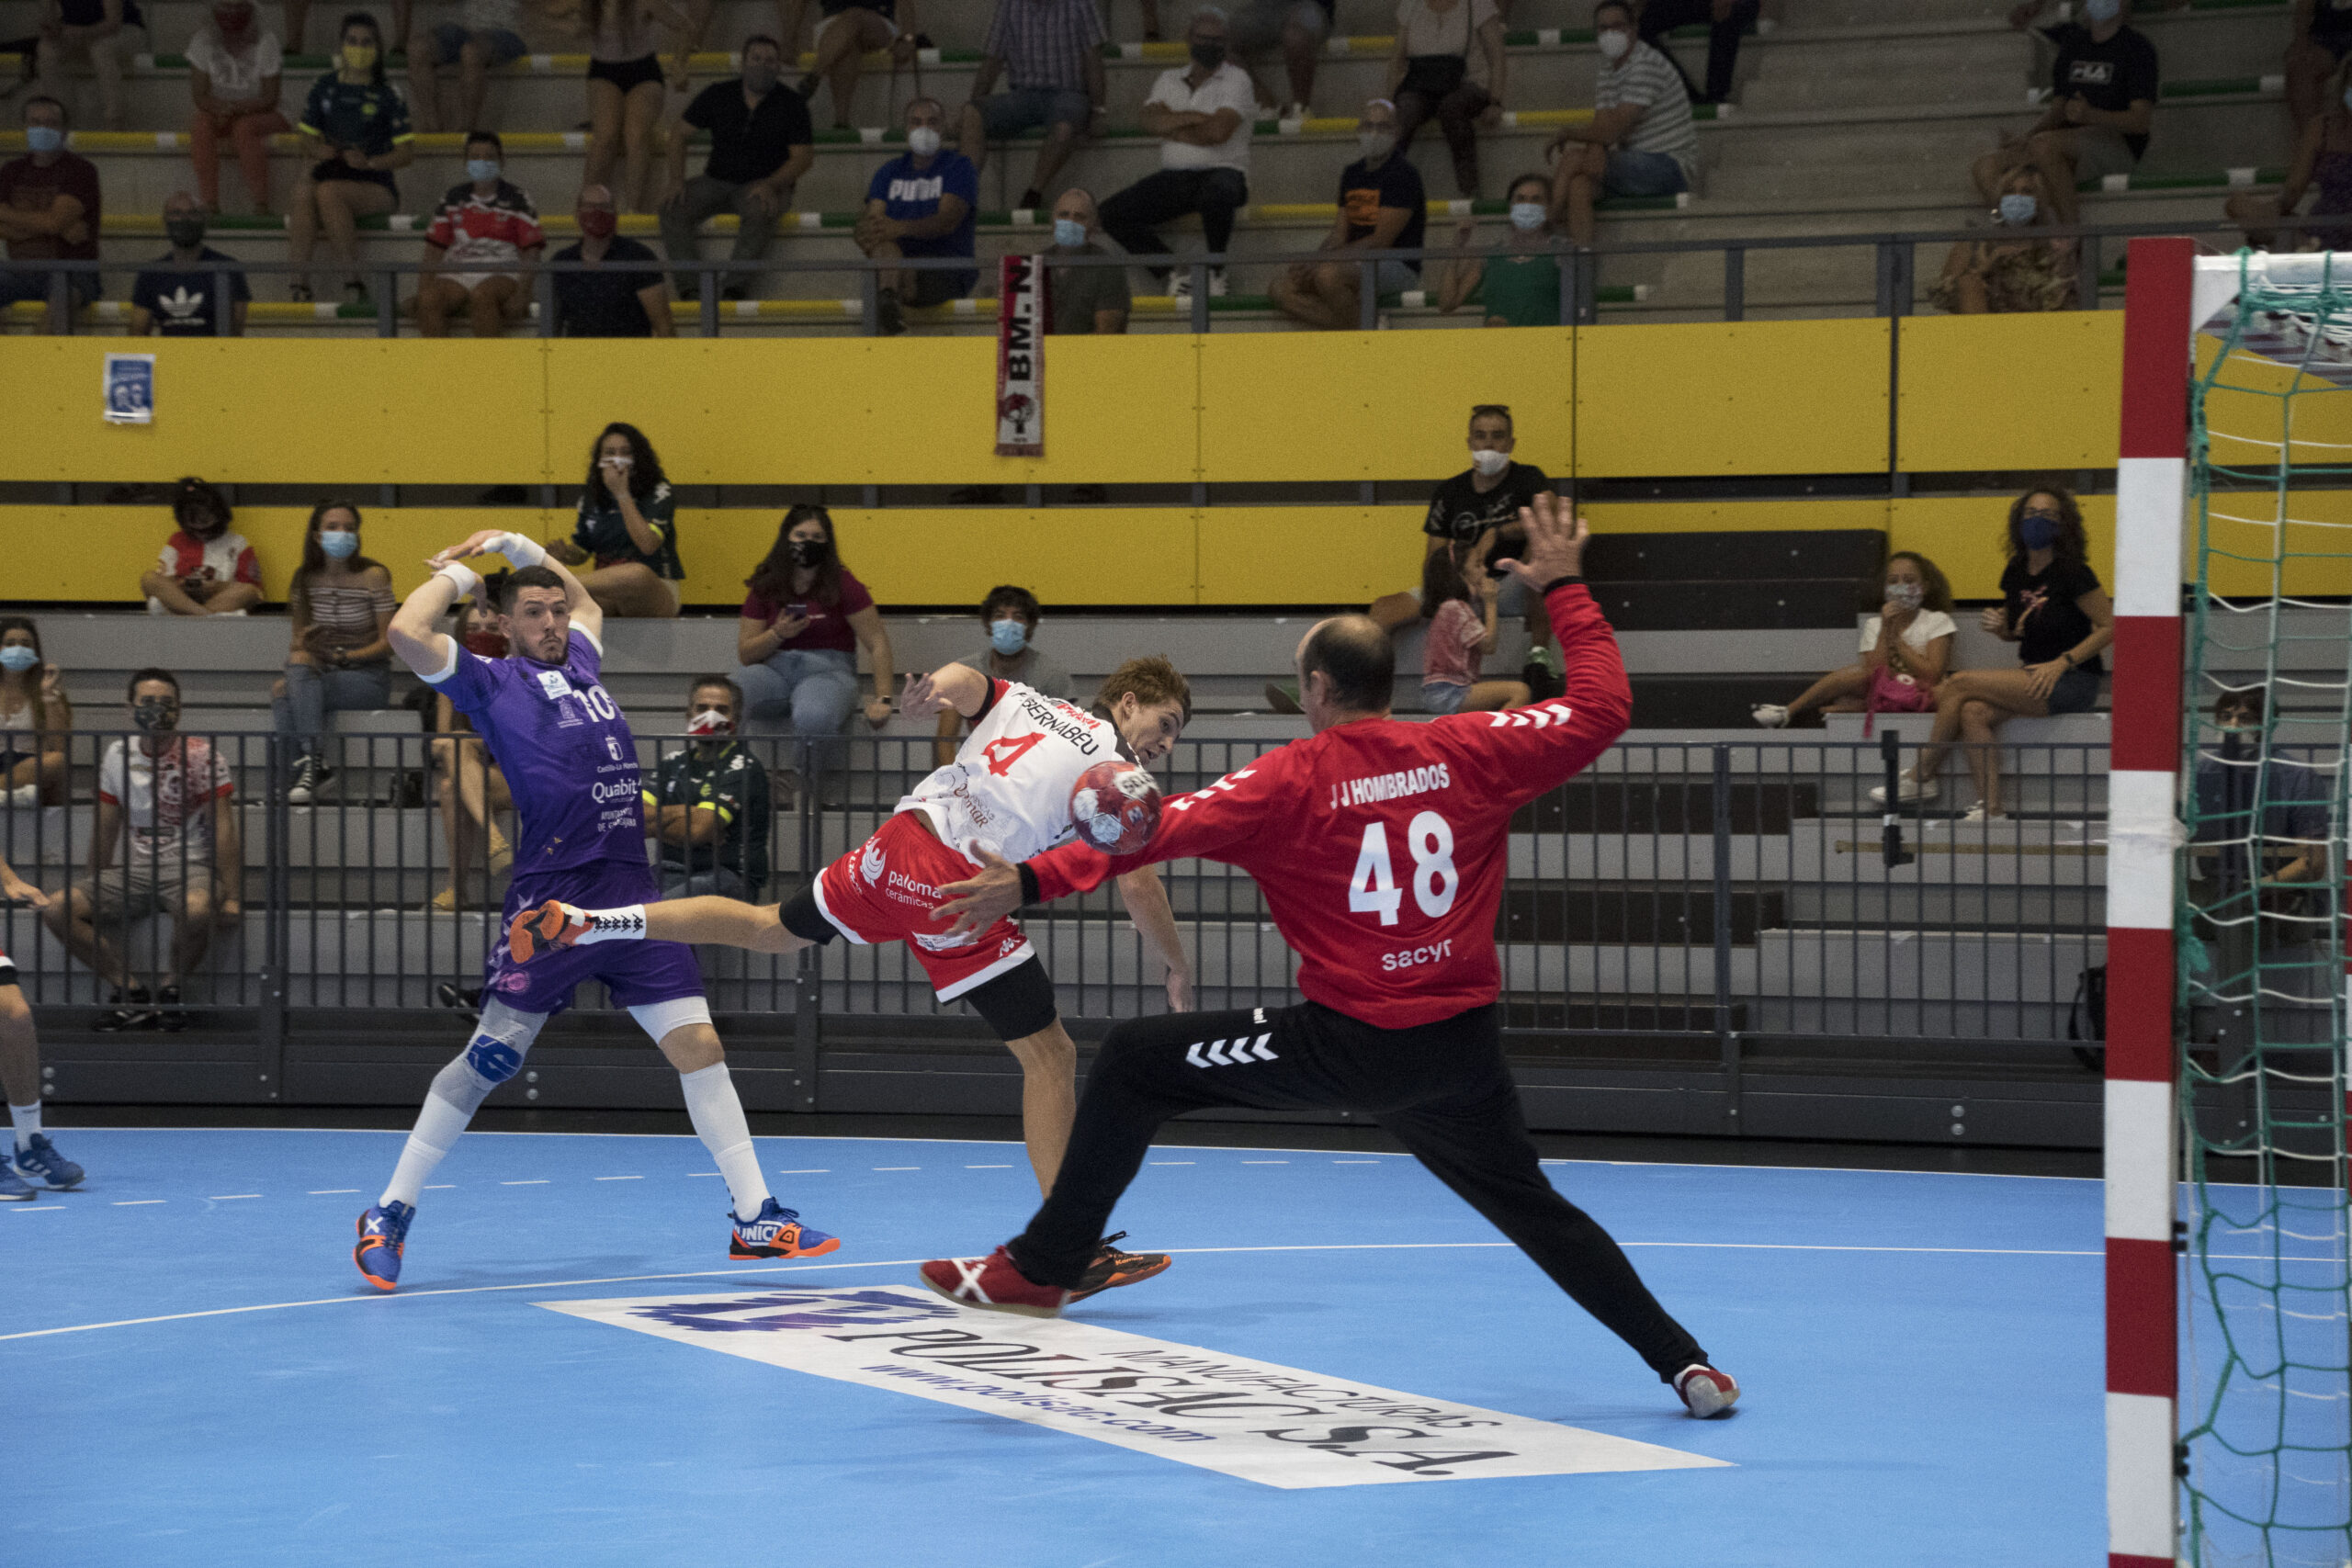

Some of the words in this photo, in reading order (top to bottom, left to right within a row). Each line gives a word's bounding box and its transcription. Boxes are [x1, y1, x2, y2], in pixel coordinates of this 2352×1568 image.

[572, 685, 616, 722] 10
[981, 731, 1046, 778] 4
[592, 778, 639, 804] Quabit
[1329, 784, 1338, 809] J
[1340, 782, 1351, 807] J
[1350, 762, 1451, 806] HOMBRADOS
[888, 870, 943, 899] paloma
[1348, 810, 1460, 927] 48
[885, 886, 934, 909] cerámicas
[1381, 939, 1453, 972] sacyr
[821, 1328, 1336, 1419] POLISAC
[1247, 1425, 1521, 1476] S.A.
[860, 1364, 1218, 1442] www.polisac.com
[1100, 1349, 1503, 1428] MANUFACTURAS
